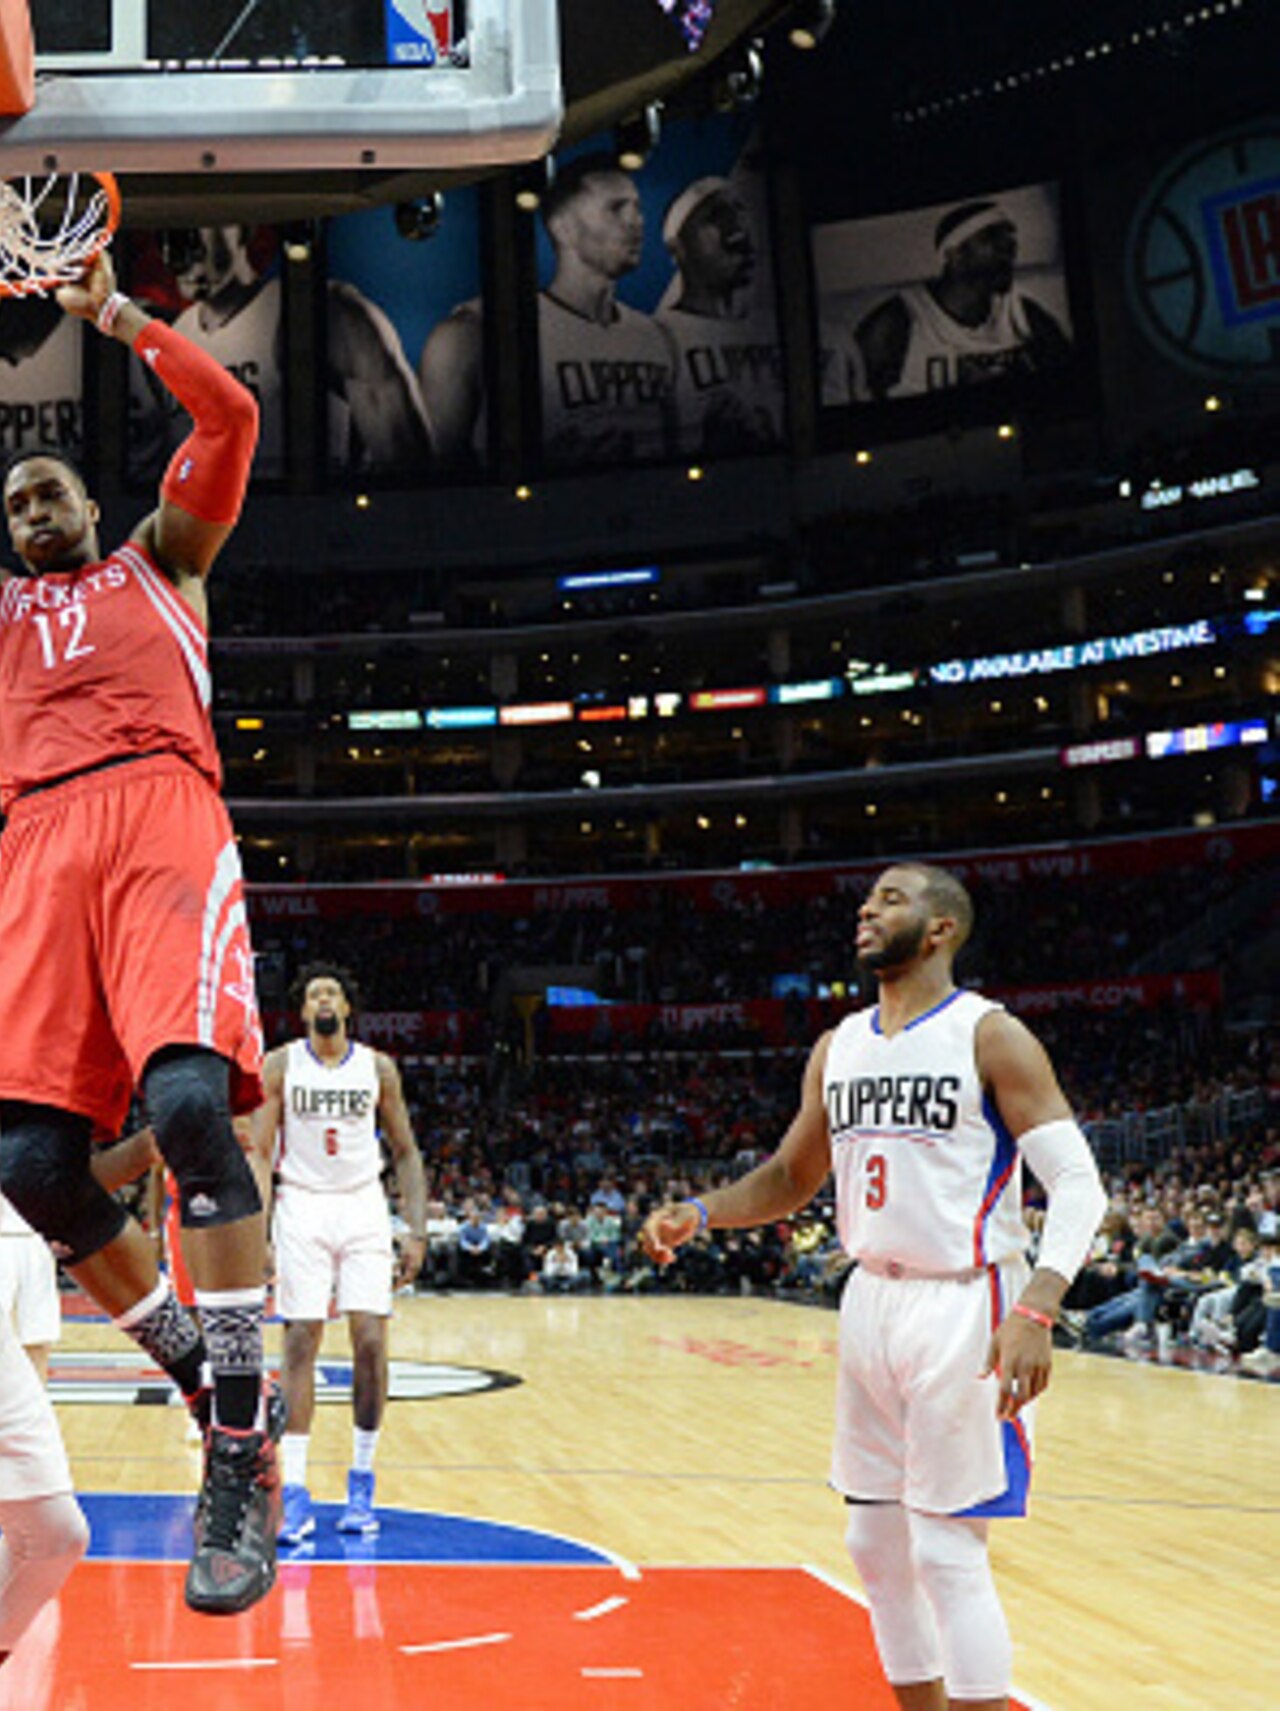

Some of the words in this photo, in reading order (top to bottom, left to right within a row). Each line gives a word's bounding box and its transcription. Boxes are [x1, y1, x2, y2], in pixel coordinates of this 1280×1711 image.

[33, 602, 96, 669] 12
[969, 645, 1075, 681] AVAILABLE
[1080, 641, 1106, 665] AT
[292, 1085, 372, 1118] CLIPPERS
[828, 1074, 961, 1136] CLIPPERS
[865, 1154, 886, 1211] 3
